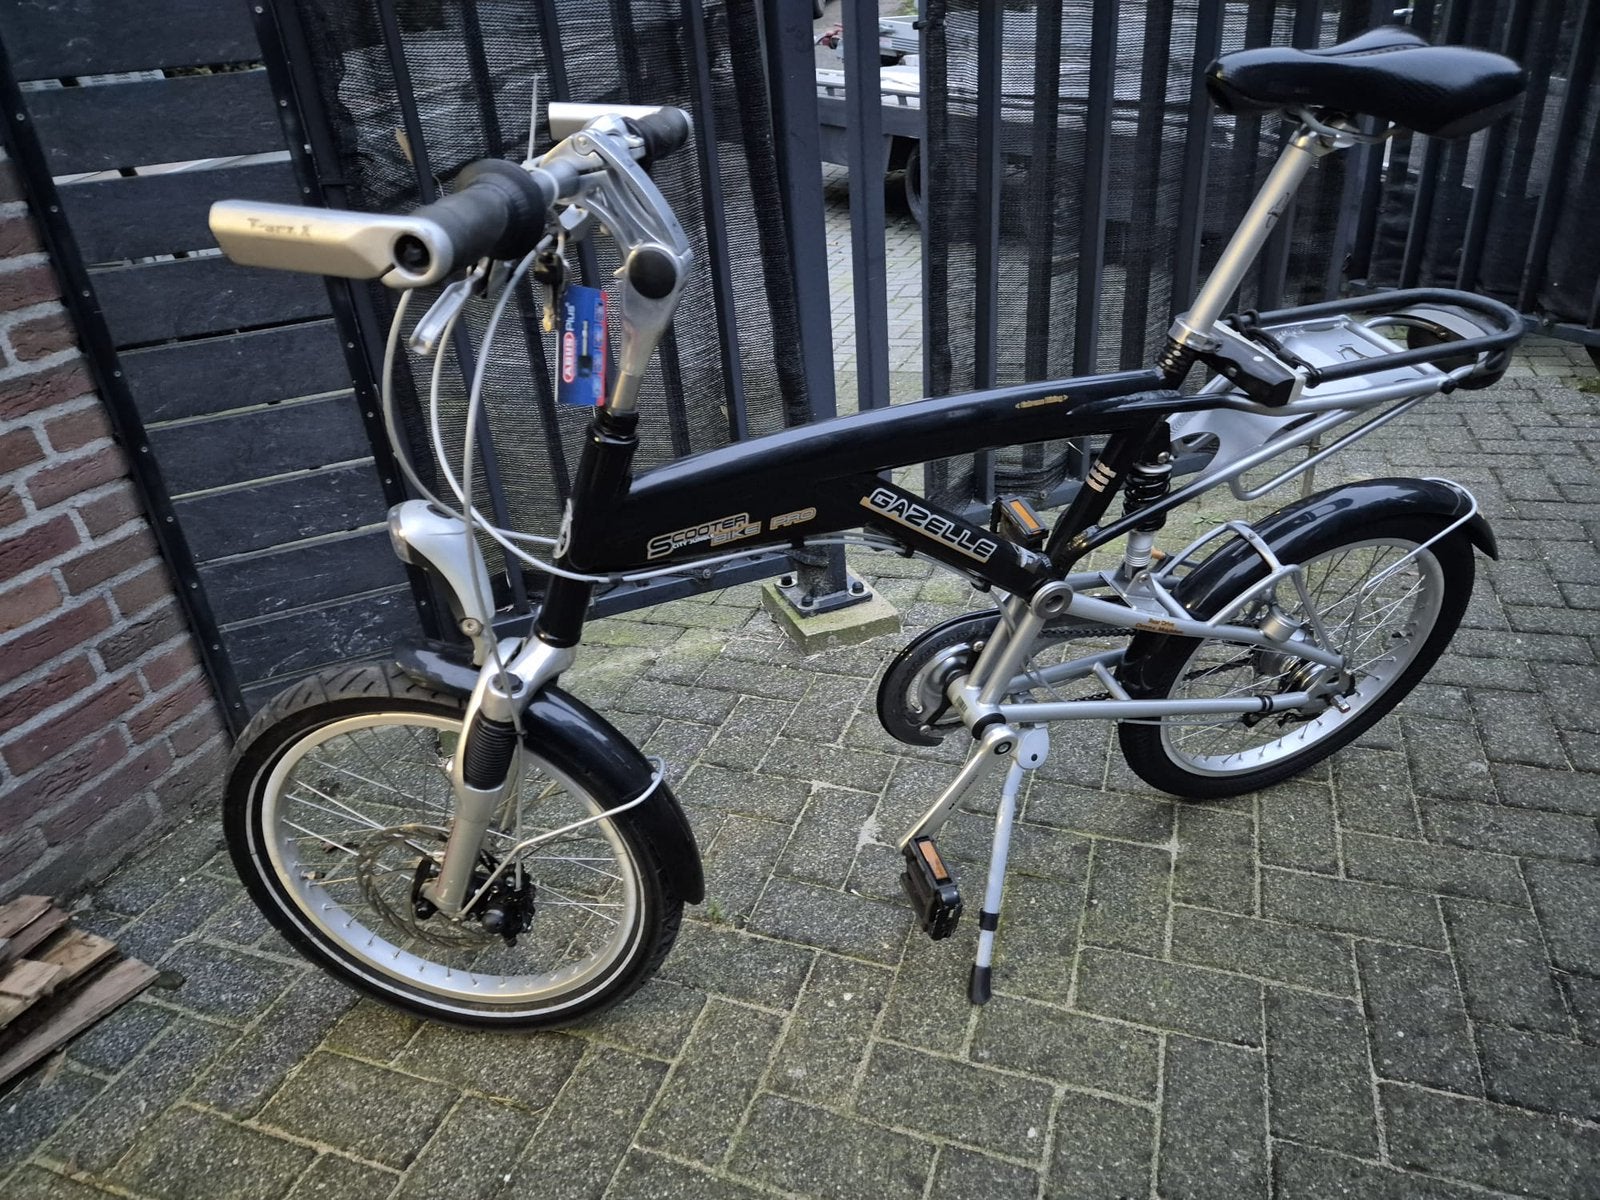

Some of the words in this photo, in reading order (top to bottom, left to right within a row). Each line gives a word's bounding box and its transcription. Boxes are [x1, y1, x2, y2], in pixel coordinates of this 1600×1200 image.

[565, 305, 576, 331] Plus
[648, 513, 749, 559] SCOOTER
[710, 521, 761, 546] BIKE
[770, 507, 816, 530] PRO
[868, 487, 998, 561] GAZELLE
[672, 540, 687, 550] CITY
